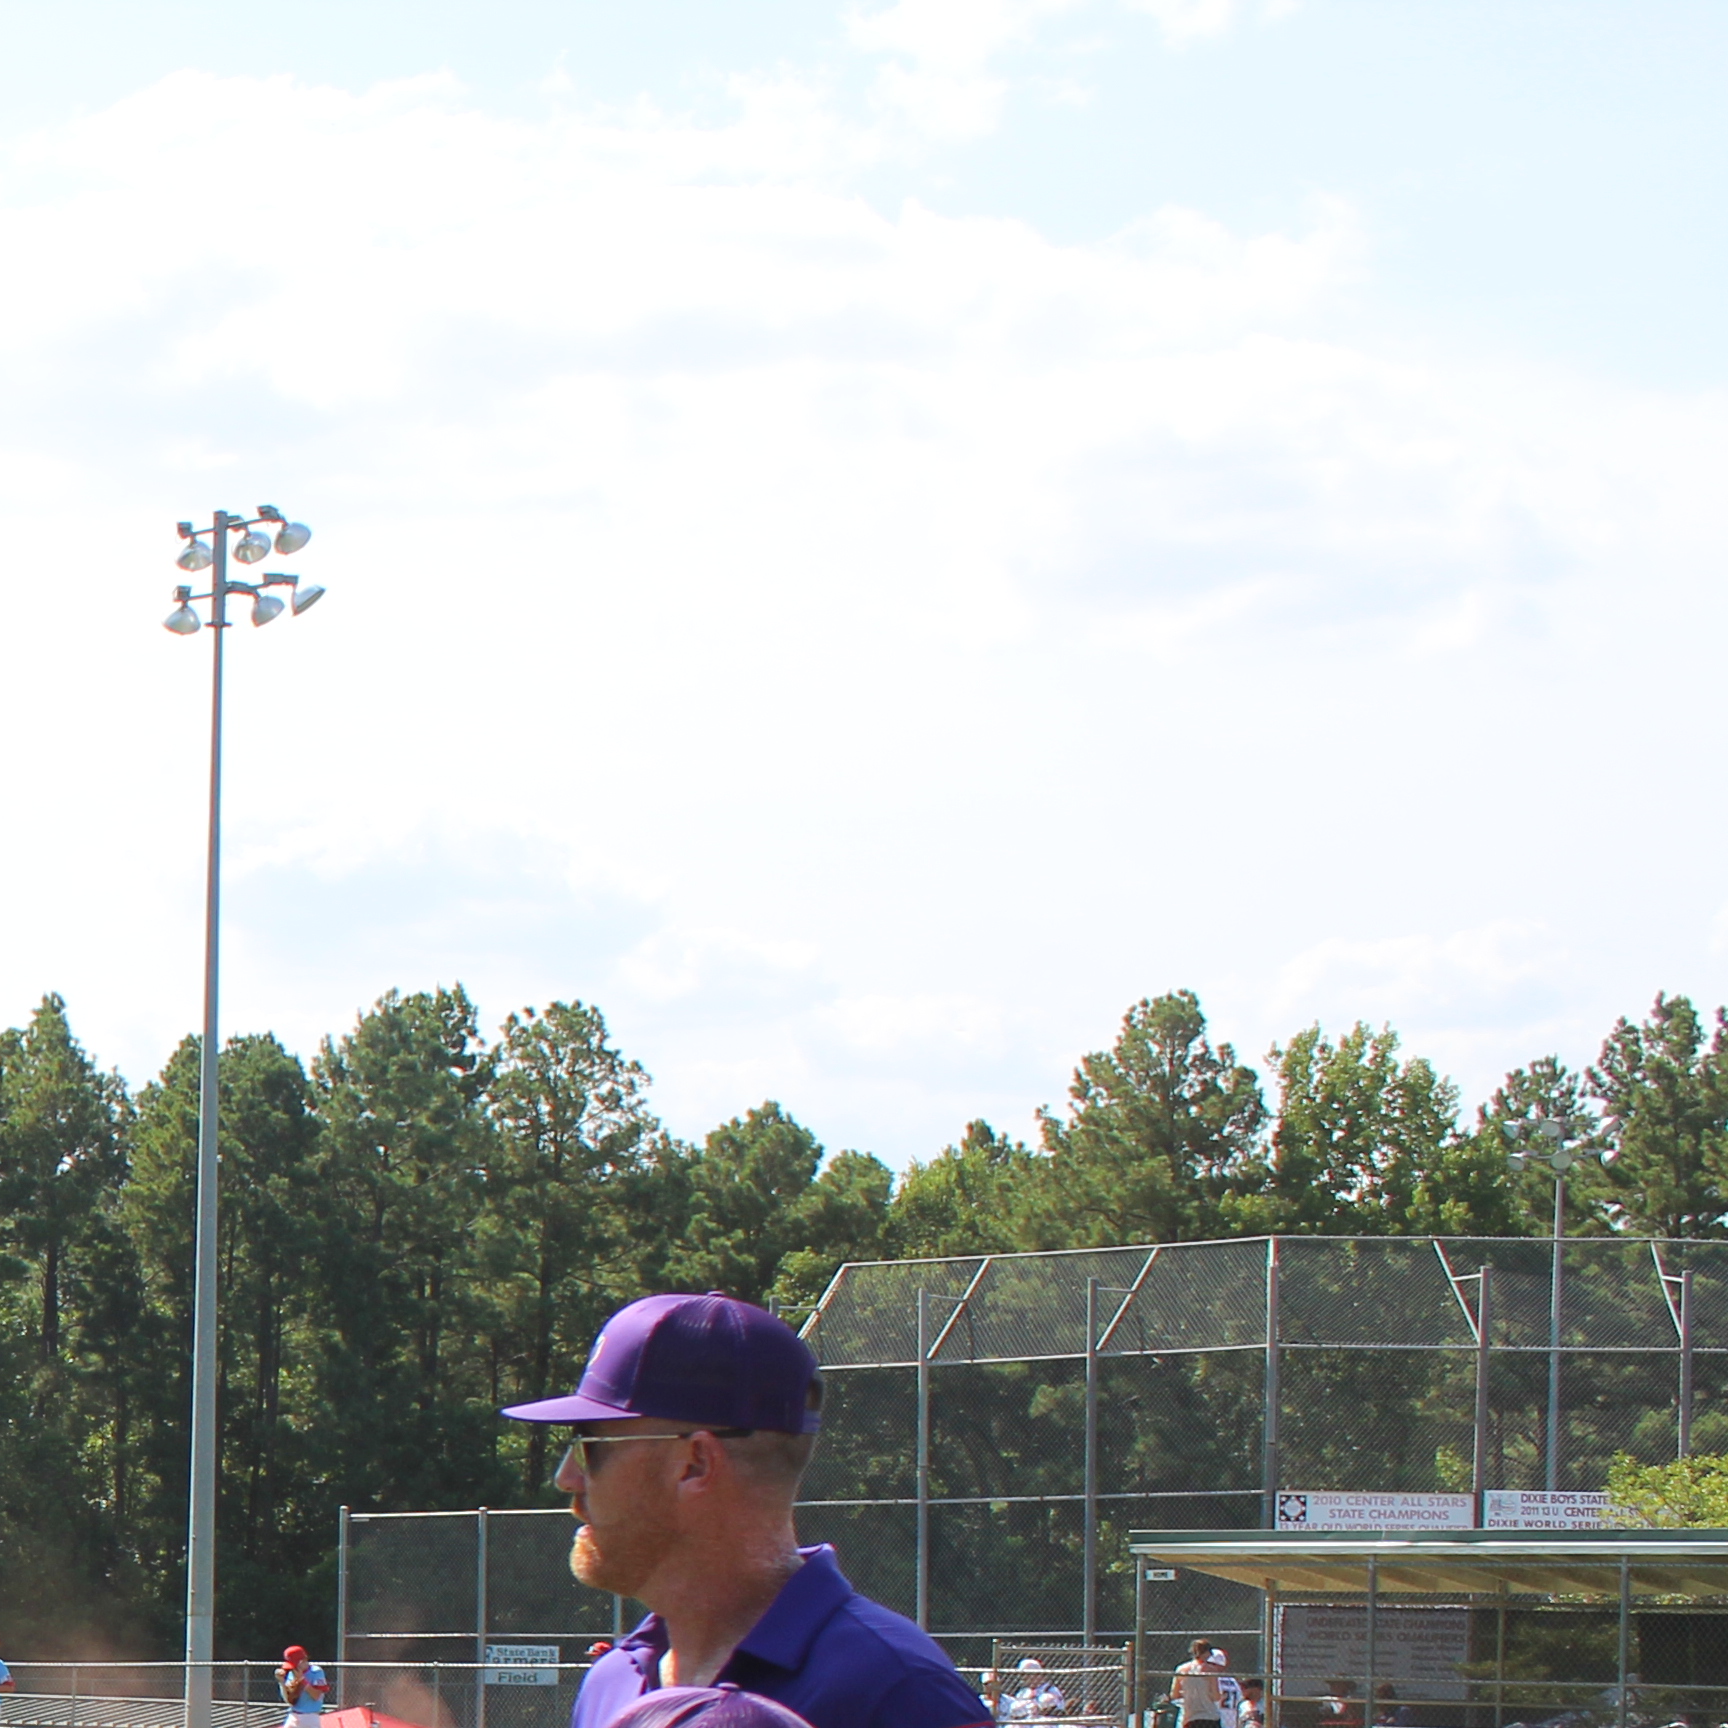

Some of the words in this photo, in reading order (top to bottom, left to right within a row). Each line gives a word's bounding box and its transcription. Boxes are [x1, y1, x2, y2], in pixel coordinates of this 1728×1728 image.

[1313, 1495, 1341, 1506] 2010
[1346, 1496, 1394, 1507] CENTER
[1398, 1496, 1423, 1507] ALL
[1428, 1497, 1467, 1508] STARS
[1520, 1493, 1547, 1504] DIXIE
[1550, 1494, 1576, 1504] BOYS
[1579, 1494, 1608, 1505] STATE
[1329, 1508, 1365, 1519] STATE
[1368, 1509, 1450, 1520] CHAMPIONS
[1520, 1506, 1541, 1516] 2011
[1564, 1507, 1602, 1517] CENTE
[1488, 1518, 1519, 1528] DIXIE
[1524, 1519, 1566, 1529] WORLD
[1571, 1520, 1603, 1530] SERIE
[497, 1647, 525, 1656] State
[527, 1647, 555, 1657] Bank
[498, 1672, 537, 1682] Field
